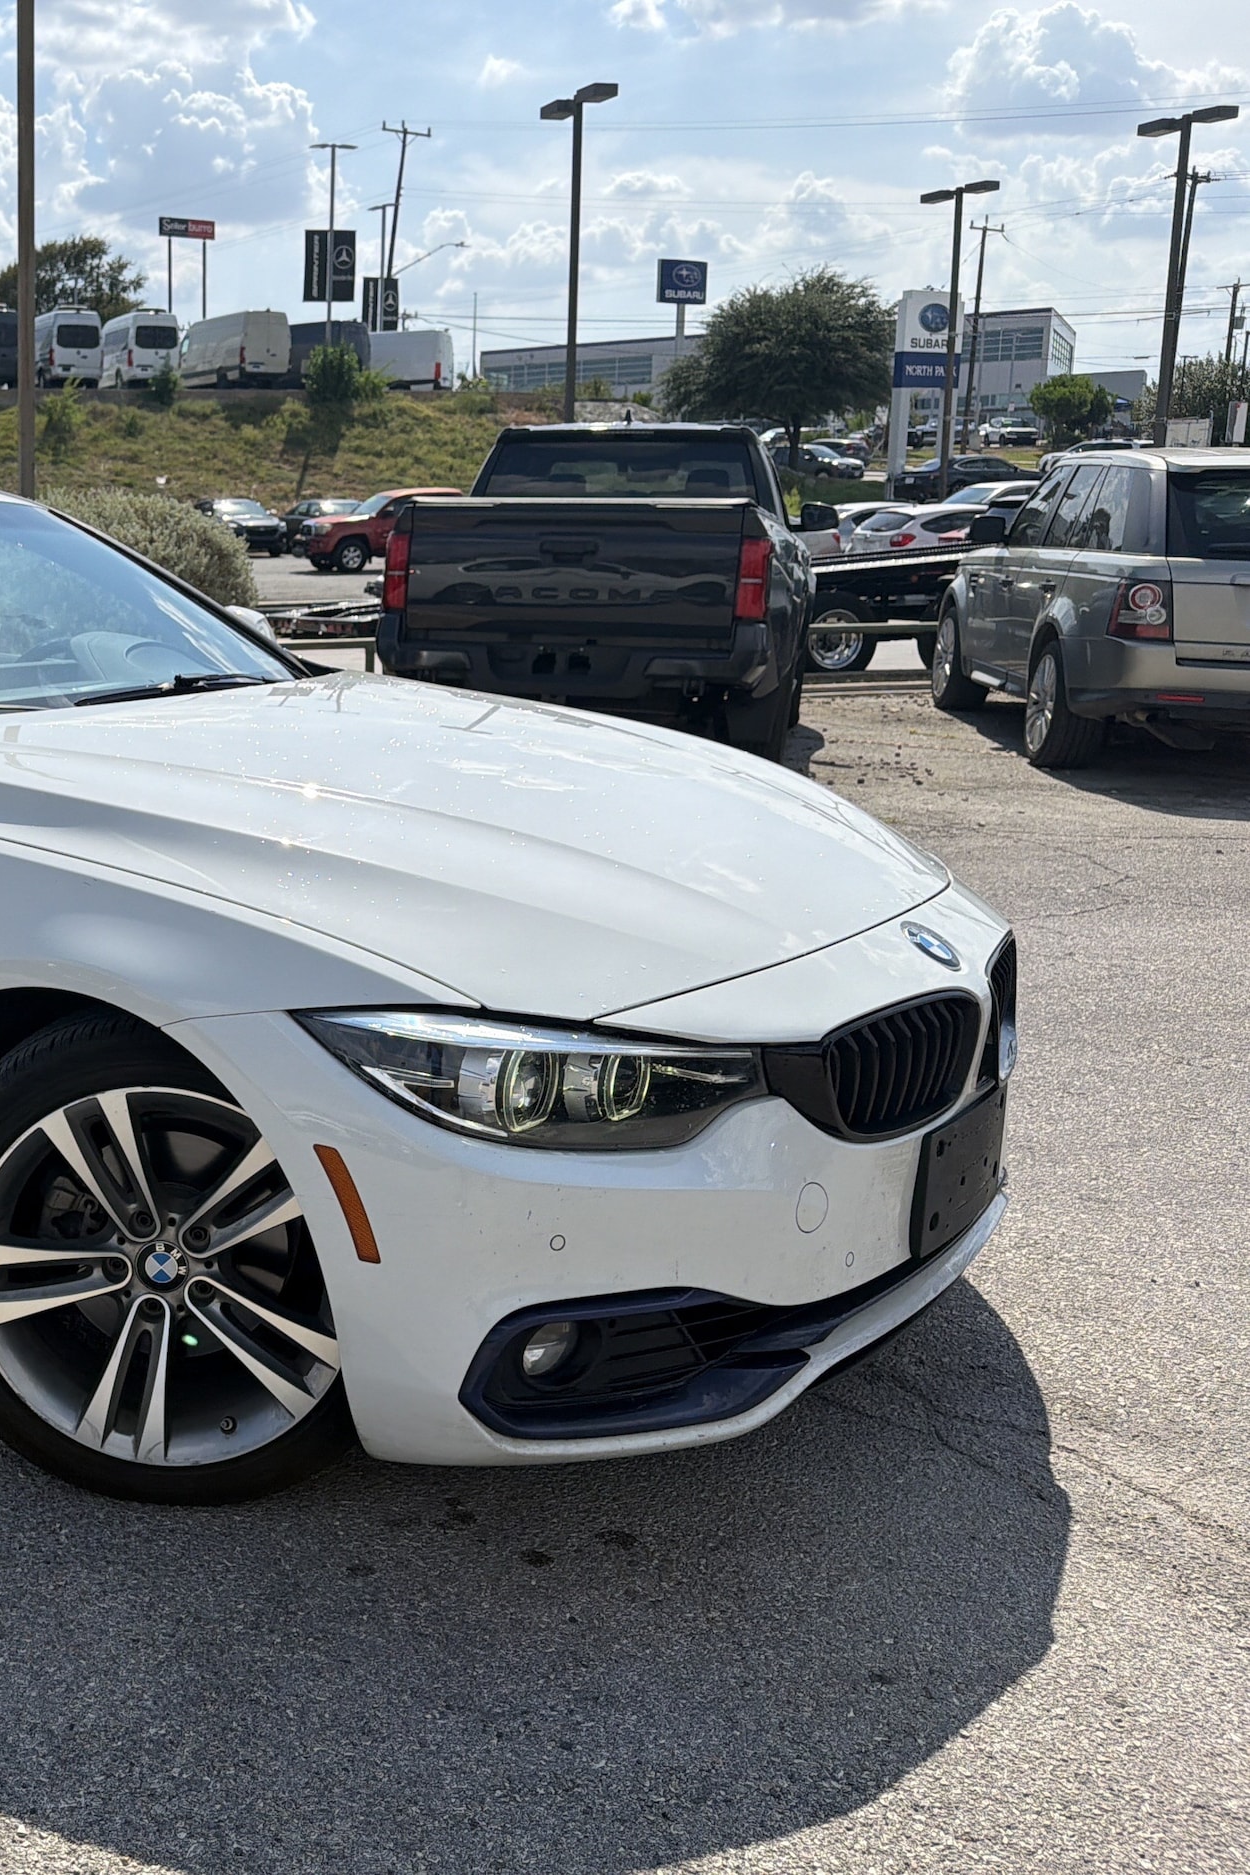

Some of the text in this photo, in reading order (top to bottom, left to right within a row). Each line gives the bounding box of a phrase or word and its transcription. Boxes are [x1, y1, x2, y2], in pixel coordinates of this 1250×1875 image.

[664, 289, 704, 300] SUBARU
[910, 337, 949, 350] SUBAR
[905, 364, 958, 377] NORTH PAK
[456, 584, 681, 602] ACOMA
[155, 1242, 187, 1276] BMW
